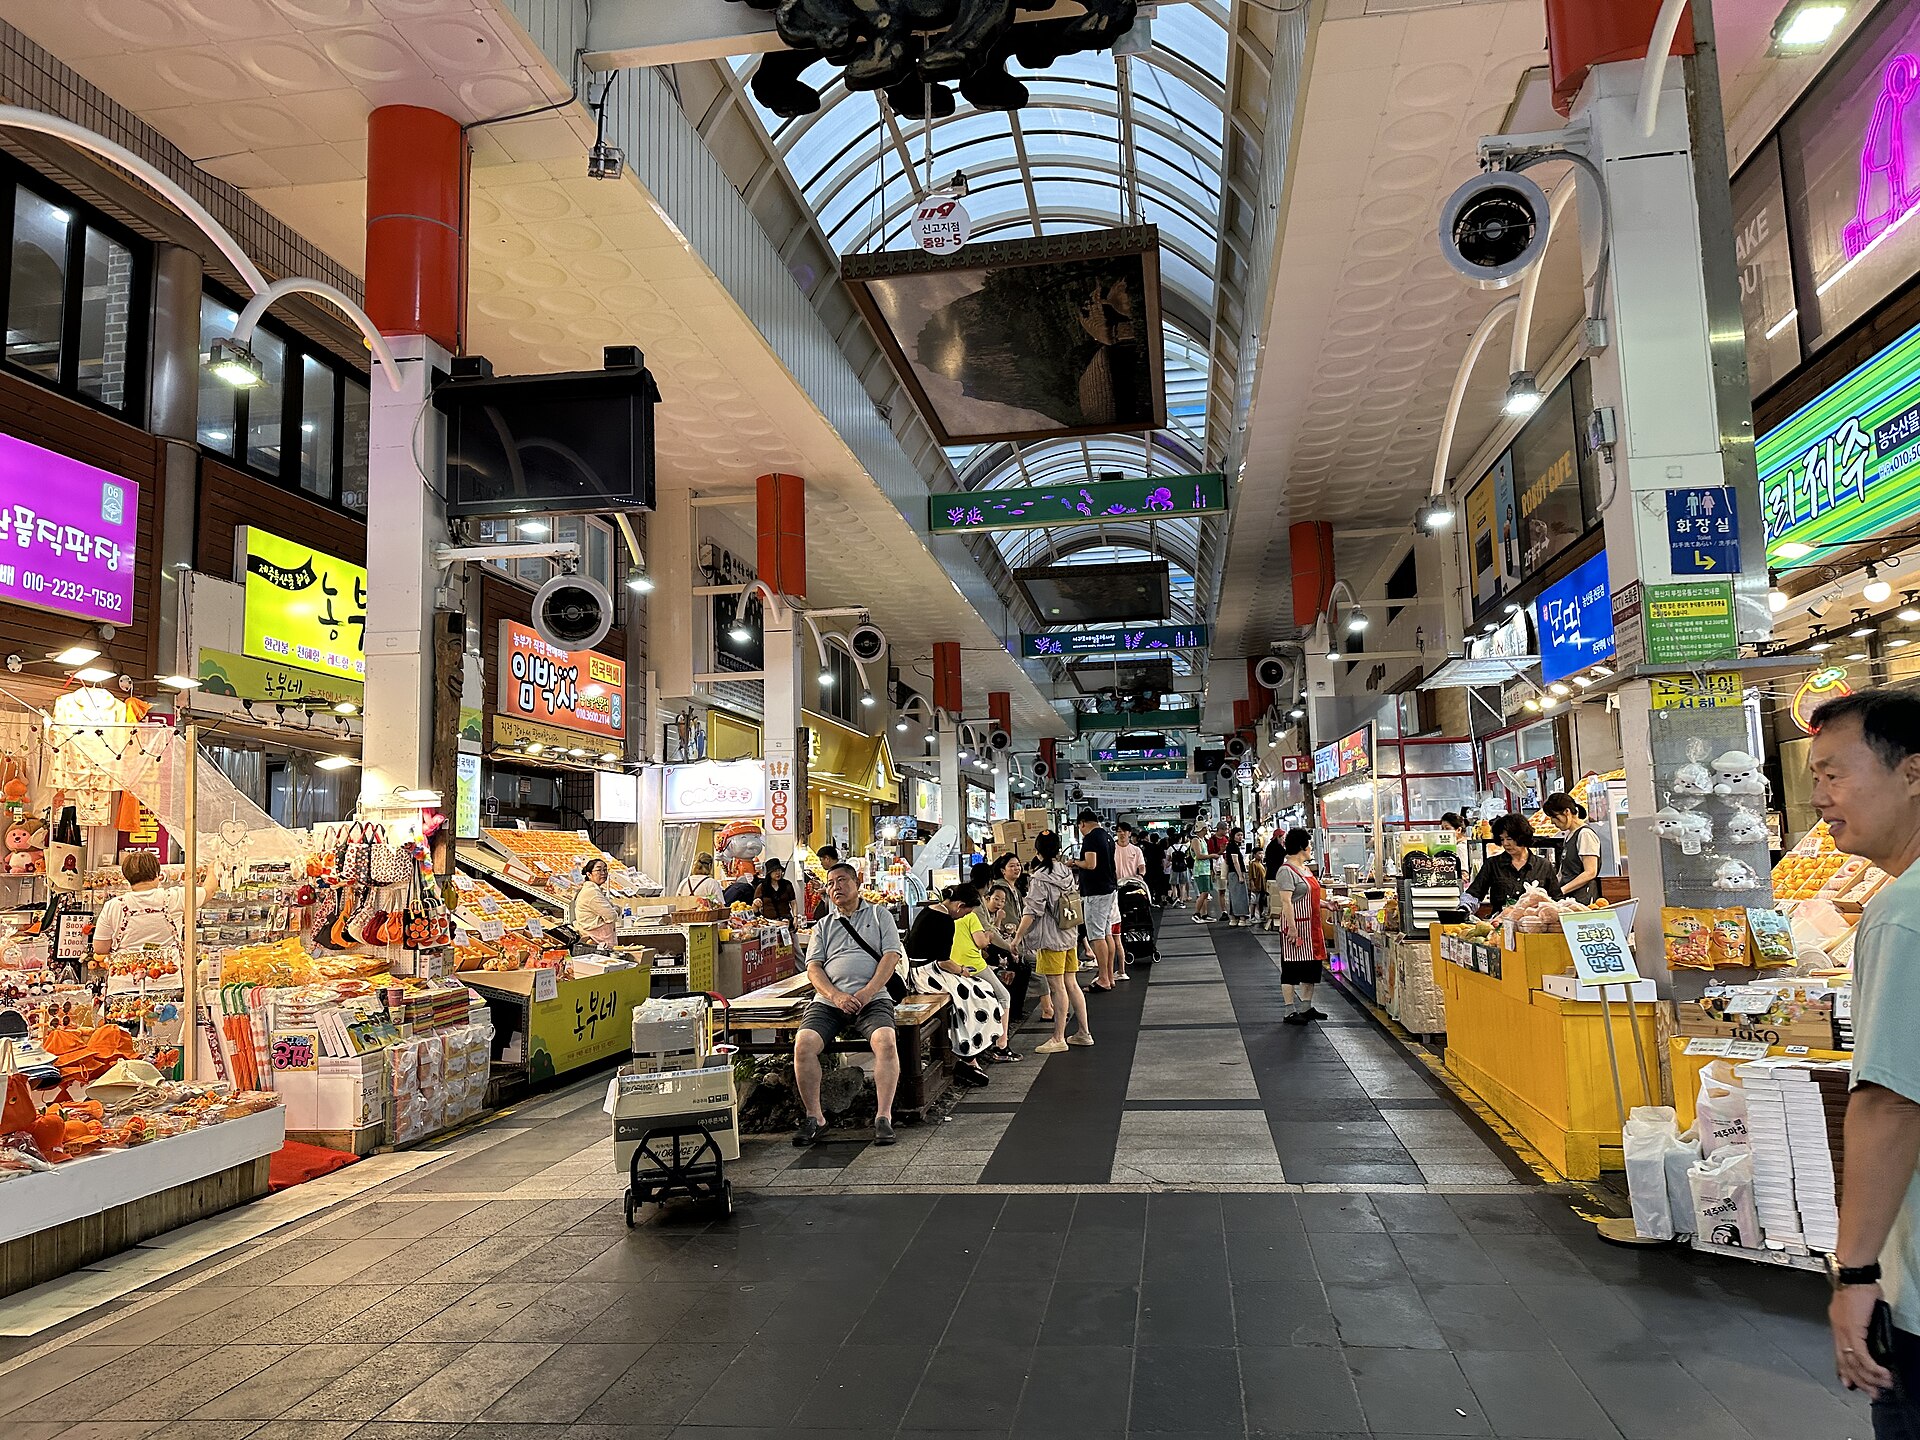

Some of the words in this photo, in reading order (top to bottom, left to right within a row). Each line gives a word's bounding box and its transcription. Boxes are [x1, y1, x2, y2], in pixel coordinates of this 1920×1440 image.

[917, 202, 956, 221] 119
[922, 222, 960, 234] 신고지점
[923, 233, 961, 249] 중앙-5
[1878, 409, 1920, 450] 농수산물
[107, 486, 119, 498] 06
[1521, 474, 1547, 519] ROBOT
[1548, 450, 1572, 493] CAFE
[1676, 518, 1730, 533] 화장실
[22, 570, 122, 611] 010-2232-7582
[264, 636, 289, 655] 한라봉
[513, 632, 532, 648] 농부가
[533, 638, 545, 654] 직접
[264, 671, 303, 699] 농부네
[512, 651, 578, 714] 임박사
[1577, 927, 1616, 943] 크런치
[1580, 943, 1622, 957] 10박스
[1587, 955, 1626, 974] 만원
[573, 990, 617, 1042] 농부네
[272, 1040, 314, 1069] 공짜
